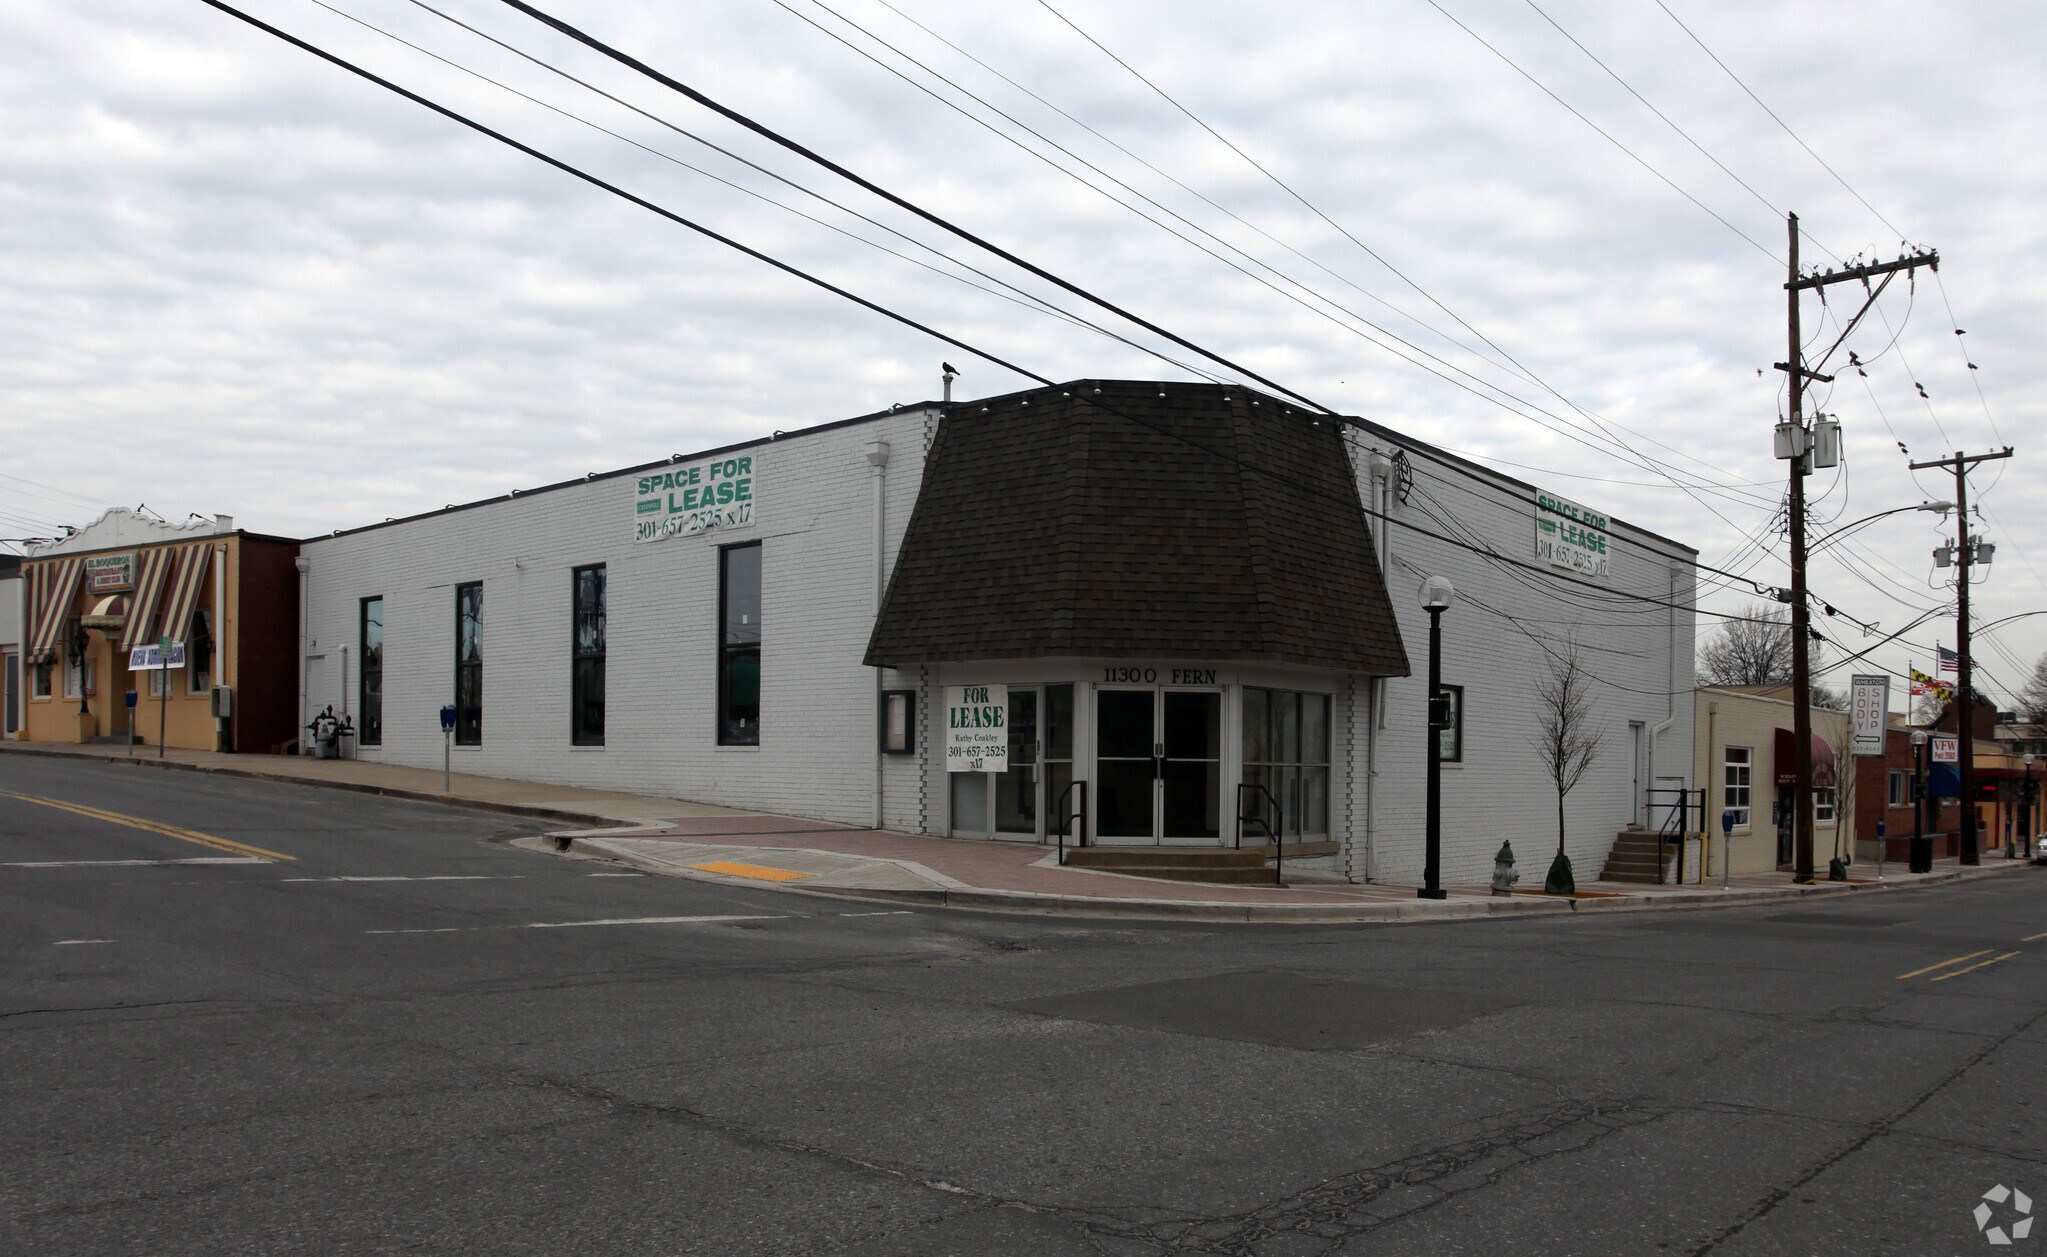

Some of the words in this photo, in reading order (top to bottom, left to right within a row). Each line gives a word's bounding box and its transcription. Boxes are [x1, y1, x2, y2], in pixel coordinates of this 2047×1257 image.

[638, 467, 700, 495] SPACE
[710, 457, 752, 481] FOR
[668, 478, 752, 514] LEASE
[1538, 495, 1578, 519] SPACE
[1583, 511, 1606, 531] FOR
[636, 509, 722, 540] 301-657-2525
[1560, 521, 1606, 555] LEASE
[1104, 667, 1157, 683] 11300
[1171, 669, 1217, 684] FERN
[963, 687, 990, 704] FOR
[949, 706, 1005, 729] LEASE
[955, 734, 972, 743] Kathy
[974, 734, 998, 743] Coakley
[1934, 740, 1957, 750] VFW
[948, 745, 1006, 758] 301-657-2525
[970, 758, 984, 769] x17
